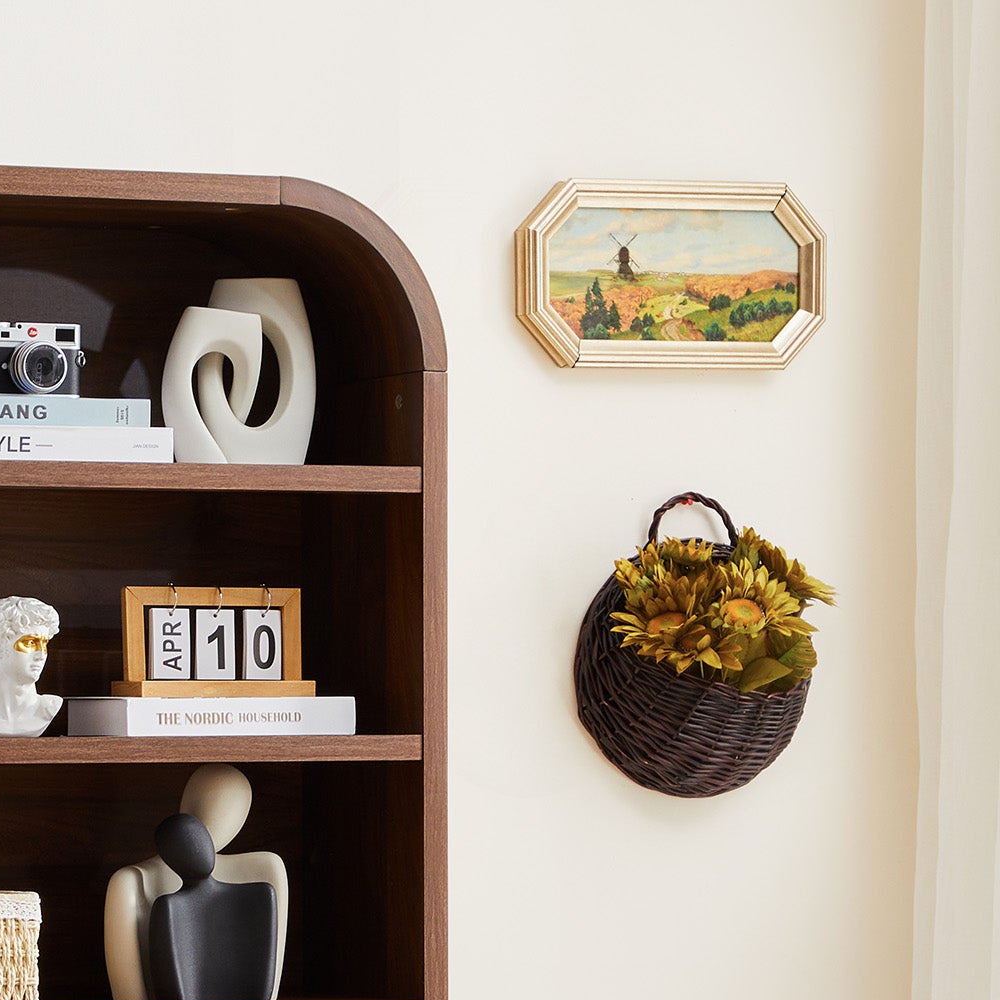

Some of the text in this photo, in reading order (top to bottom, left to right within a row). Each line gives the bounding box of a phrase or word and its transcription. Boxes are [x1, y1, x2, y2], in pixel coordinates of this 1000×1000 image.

[163, 621, 182, 671] APR
[156, 711, 301, 725] THE NORDIC HOUSEHOLD
